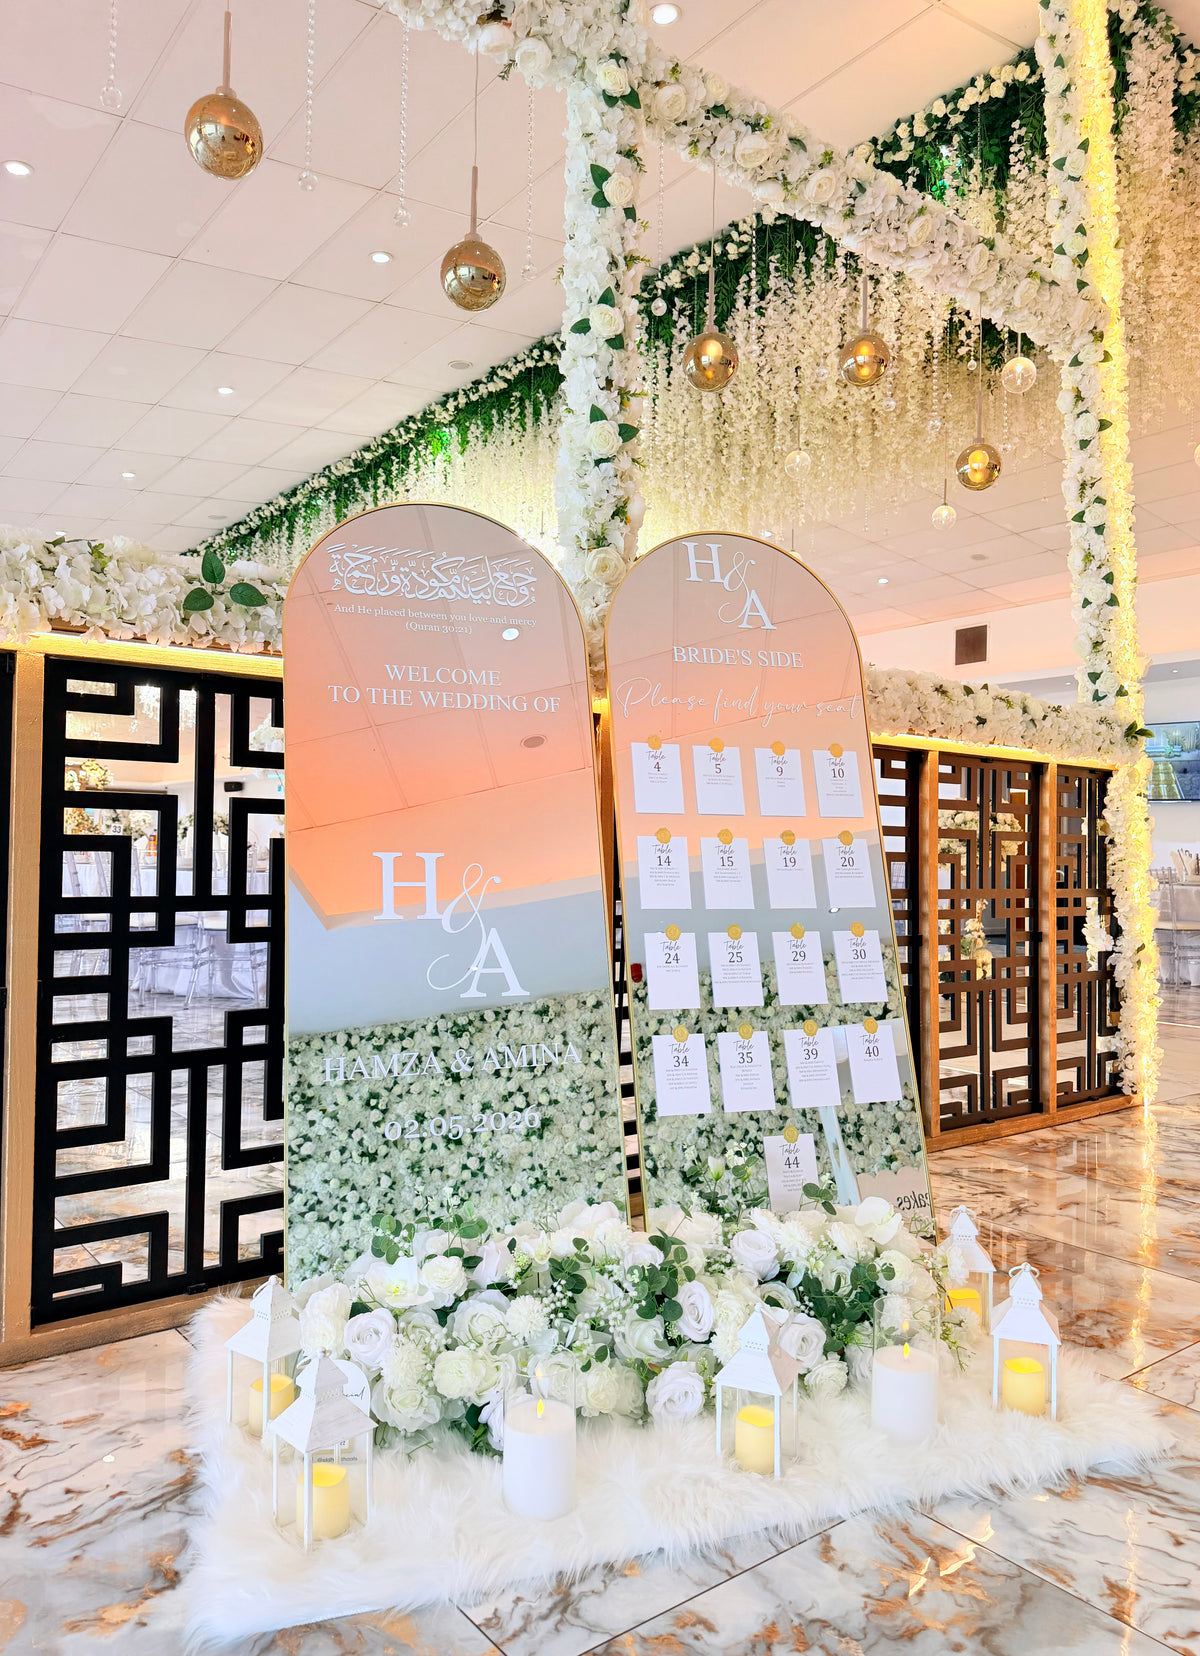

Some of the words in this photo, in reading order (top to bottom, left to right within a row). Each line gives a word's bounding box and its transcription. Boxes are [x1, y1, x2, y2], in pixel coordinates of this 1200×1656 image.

[334, 604, 355, 613] And
[357, 606, 372, 615] He
[374, 607, 405, 618] placed
[408, 609, 447, 620] between
[450, 613, 466, 624] you
[469, 613, 487, 623] love
[490, 614, 507, 624] and
[509, 617, 536, 627] mercy
[405, 621, 440, 632] (Quran
[442, 624, 472, 635] 30:21)
[673, 646, 752, 666] BRIDE'S
[758, 651, 804, 668] SIDE
[385, 664, 502, 686] WELCOME
[328, 685, 360, 704] TO
[366, 687, 413, 706] THE
[419, 690, 533, 712] WEDDING
[534, 696, 560, 713] OF
[616, 677, 707, 718] Please
[713, 686, 759, 724] find
[763, 700, 808, 728] your
[816, 694, 862, 720] seat
[645, 750, 667, 760] Table
[707, 752, 727, 762] Table
[653, 761, 661, 772] 4
[769, 756, 788, 766] Table
[826, 758, 845, 767] Table
[715, 764, 722, 774] 5
[776, 766, 783, 776] 9
[831, 768, 845, 778] 10
[112, 825, 122, 834] 33
[652, 844, 673, 855] Table
[715, 845, 735, 855] Table
[777, 846, 797, 856] Table
[836, 846, 855, 856] Table
[657, 855, 671, 866] 14
[720, 856, 734, 867] 15
[783, 856, 796, 868] 19
[840, 857, 855, 867] 20
[660, 941, 681, 951] Table
[724, 941, 744, 951] Table
[786, 940, 806, 950] Table
[848, 938, 867, 948] Table
[664, 952, 680, 964] 24
[728, 951, 743, 963] 25
[791, 951, 806, 962] 29
[852, 949, 866, 960] 30
[798, 1036, 819, 1048] Table
[860, 1034, 879, 1045] Table
[668, 1043, 690, 1054] Table
[733, 1040, 755, 1051] Table
[865, 1045, 879, 1057] 40
[738, 1052, 753, 1064] 35
[803, 1048, 818, 1060] 39
[323, 1051, 443, 1082] HAMZA
[451, 1049, 474, 1073] &
[481, 1041, 582, 1071] AMINA
[673, 1055, 689, 1067] 34
[384, 1104, 541, 1141] 02.05.2026
[779, 1143, 800, 1156] Table
[784, 1156, 800, 1168] 44
